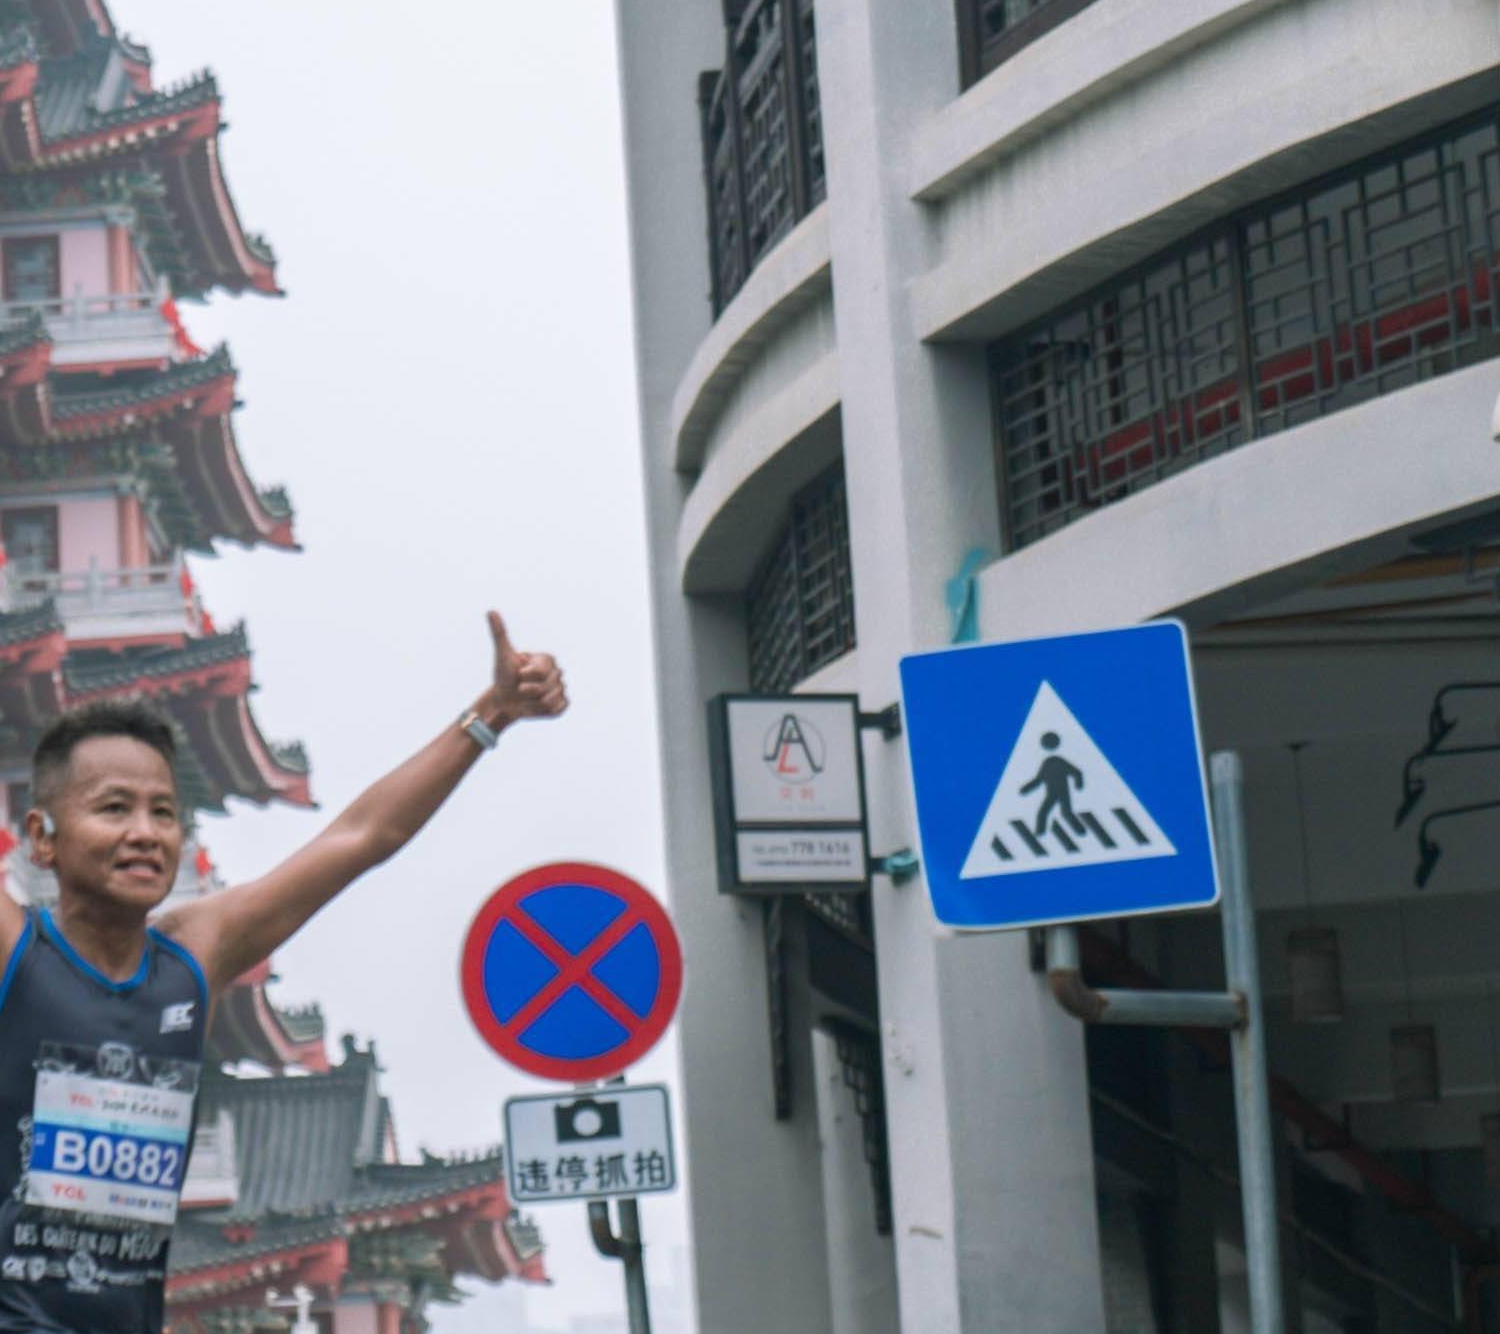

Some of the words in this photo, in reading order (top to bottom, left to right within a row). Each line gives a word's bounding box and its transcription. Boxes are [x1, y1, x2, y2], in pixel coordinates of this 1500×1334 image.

[53, 1129, 179, 1188] B0882
[518, 1151, 667, 1195] 违停抓拍
